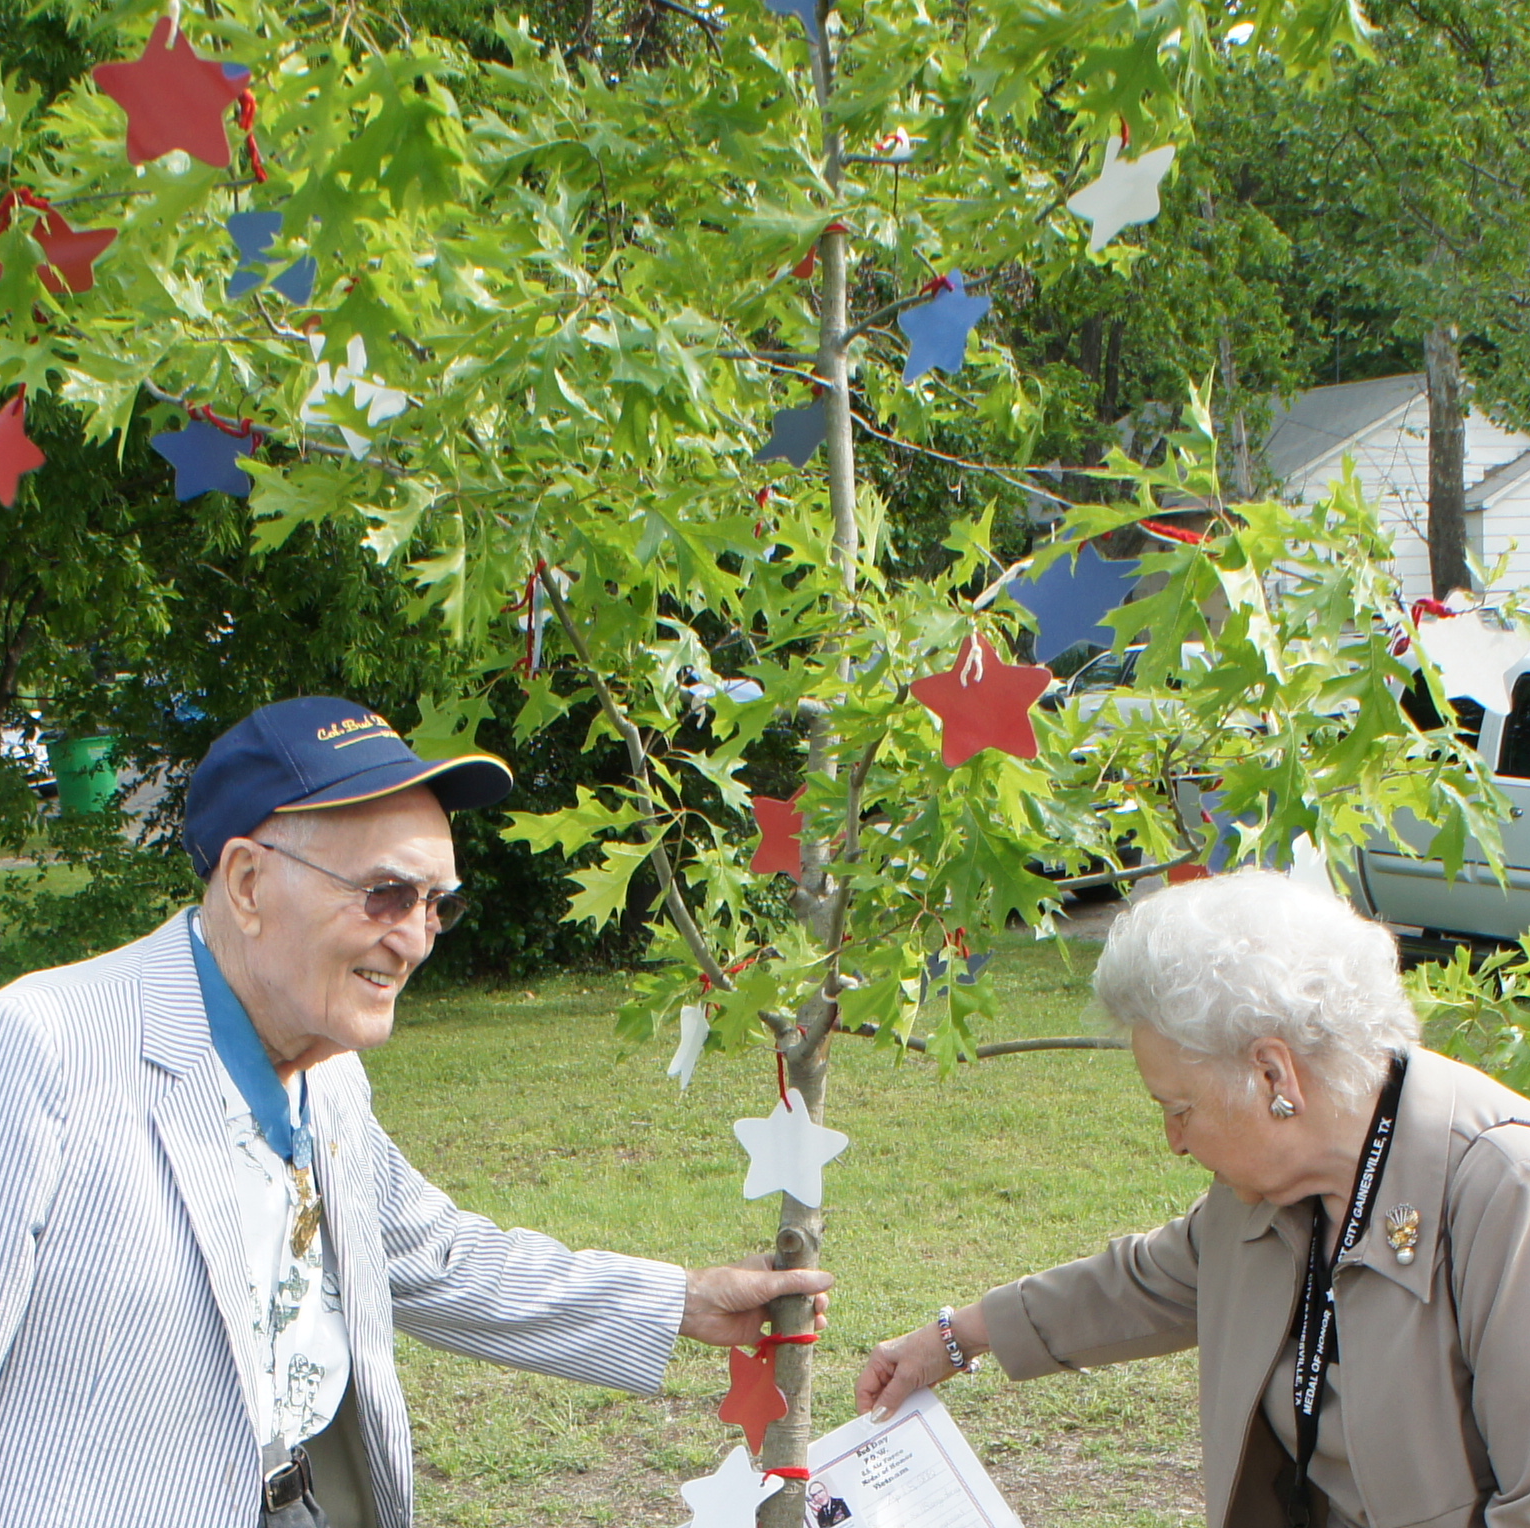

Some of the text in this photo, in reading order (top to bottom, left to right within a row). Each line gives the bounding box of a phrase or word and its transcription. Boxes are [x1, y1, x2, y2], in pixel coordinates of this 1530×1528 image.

[342, 714, 374, 733] Bud
[1343, 1217, 1360, 1247] CITY
[1353, 1137, 1388, 1219] GAINESVILLE,
[1377, 1116, 1393, 1134] TX
[1302, 1309, 1332, 1416] MEDAL OF HONOR
[870, 1436, 888, 1450] Day
